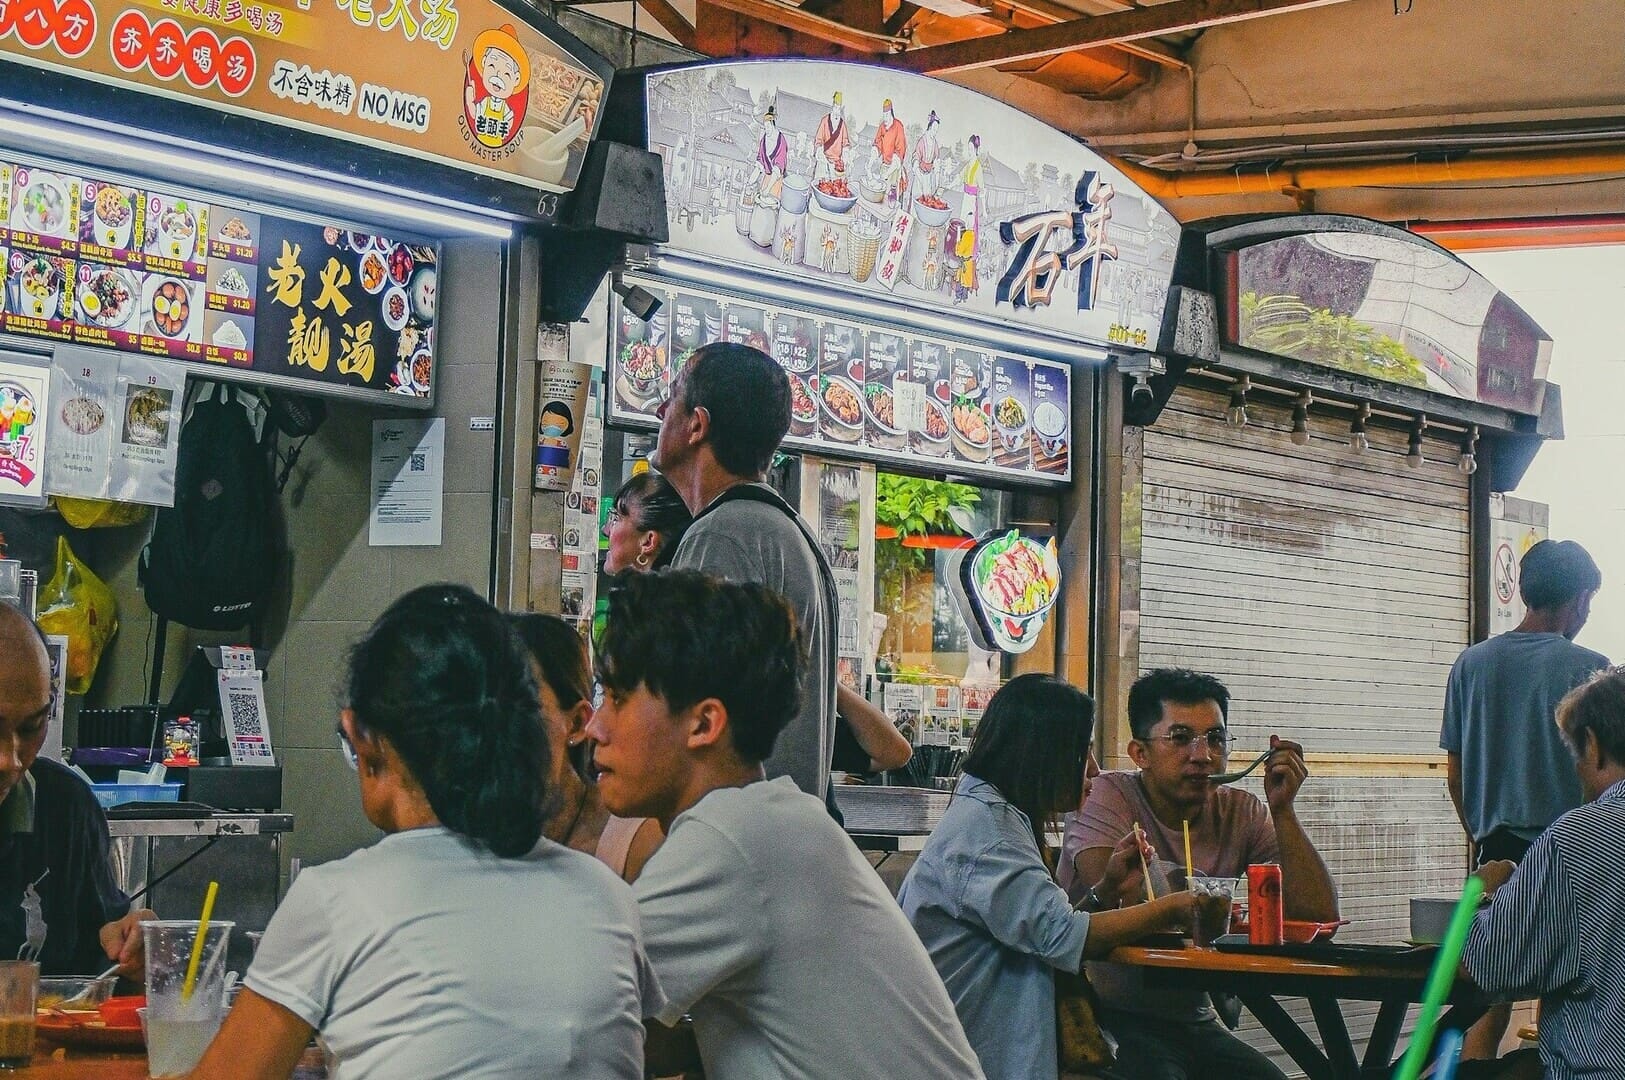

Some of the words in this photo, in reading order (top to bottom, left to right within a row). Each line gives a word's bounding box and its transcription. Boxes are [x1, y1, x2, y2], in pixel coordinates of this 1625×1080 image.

[119, 27, 247, 83] 齐齐喝汤
[274, 66, 352, 109] 不含味精
[362, 90, 390, 117] NO
[391, 98, 427, 127] MSG
[457, 114, 471, 141] OLD
[469, 141, 503, 162] MASTER
[504, 130, 525, 157] SOUP
[537, 193, 559, 217] 63
[82, 367, 91, 378] 18
[147, 375, 157, 385] 19
